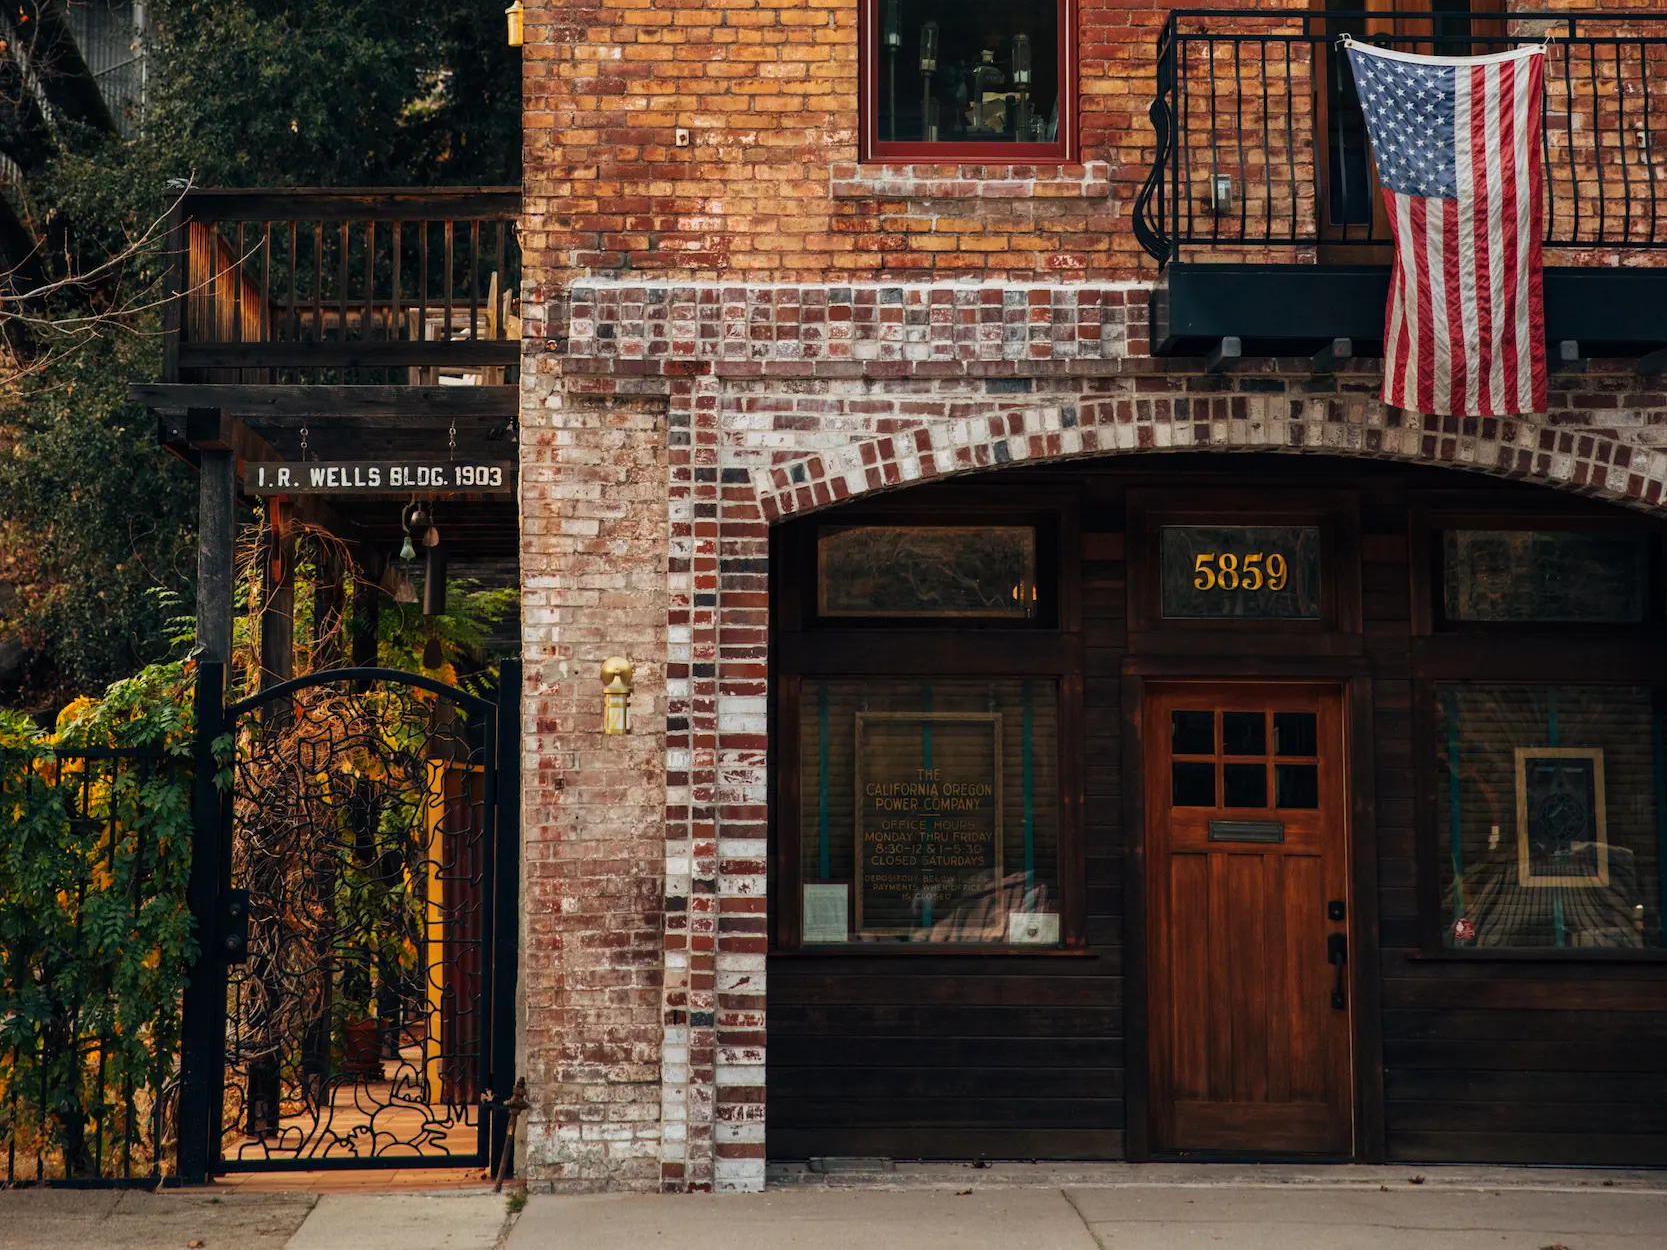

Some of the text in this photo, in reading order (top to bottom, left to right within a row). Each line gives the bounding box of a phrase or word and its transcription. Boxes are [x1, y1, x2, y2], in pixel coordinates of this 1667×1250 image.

[310, 467, 381, 487] WELLS
[389, 466, 449, 486] BLDG.
[455, 466, 502, 486] 1903
[1193, 552, 1288, 591] 5859
[916, 768, 941, 781] THE
[866, 783, 992, 796] CALIFORNIA OREGON
[875, 798, 980, 811] POWER COMPANY
[881, 820, 976, 830] OFFICE HOURS
[865, 832, 993, 842] MONDAY THRU FRIDAY
[926, 844, 936, 854] &
[871, 855, 985, 866] CLOSED SATURDAYS
[864, 874, 918, 882] DEPOSITORY
[923, 875, 954, 883] BELOW
[951, 884, 981, 892] OFFICE
[914, 893, 951, 901] CLOSED
